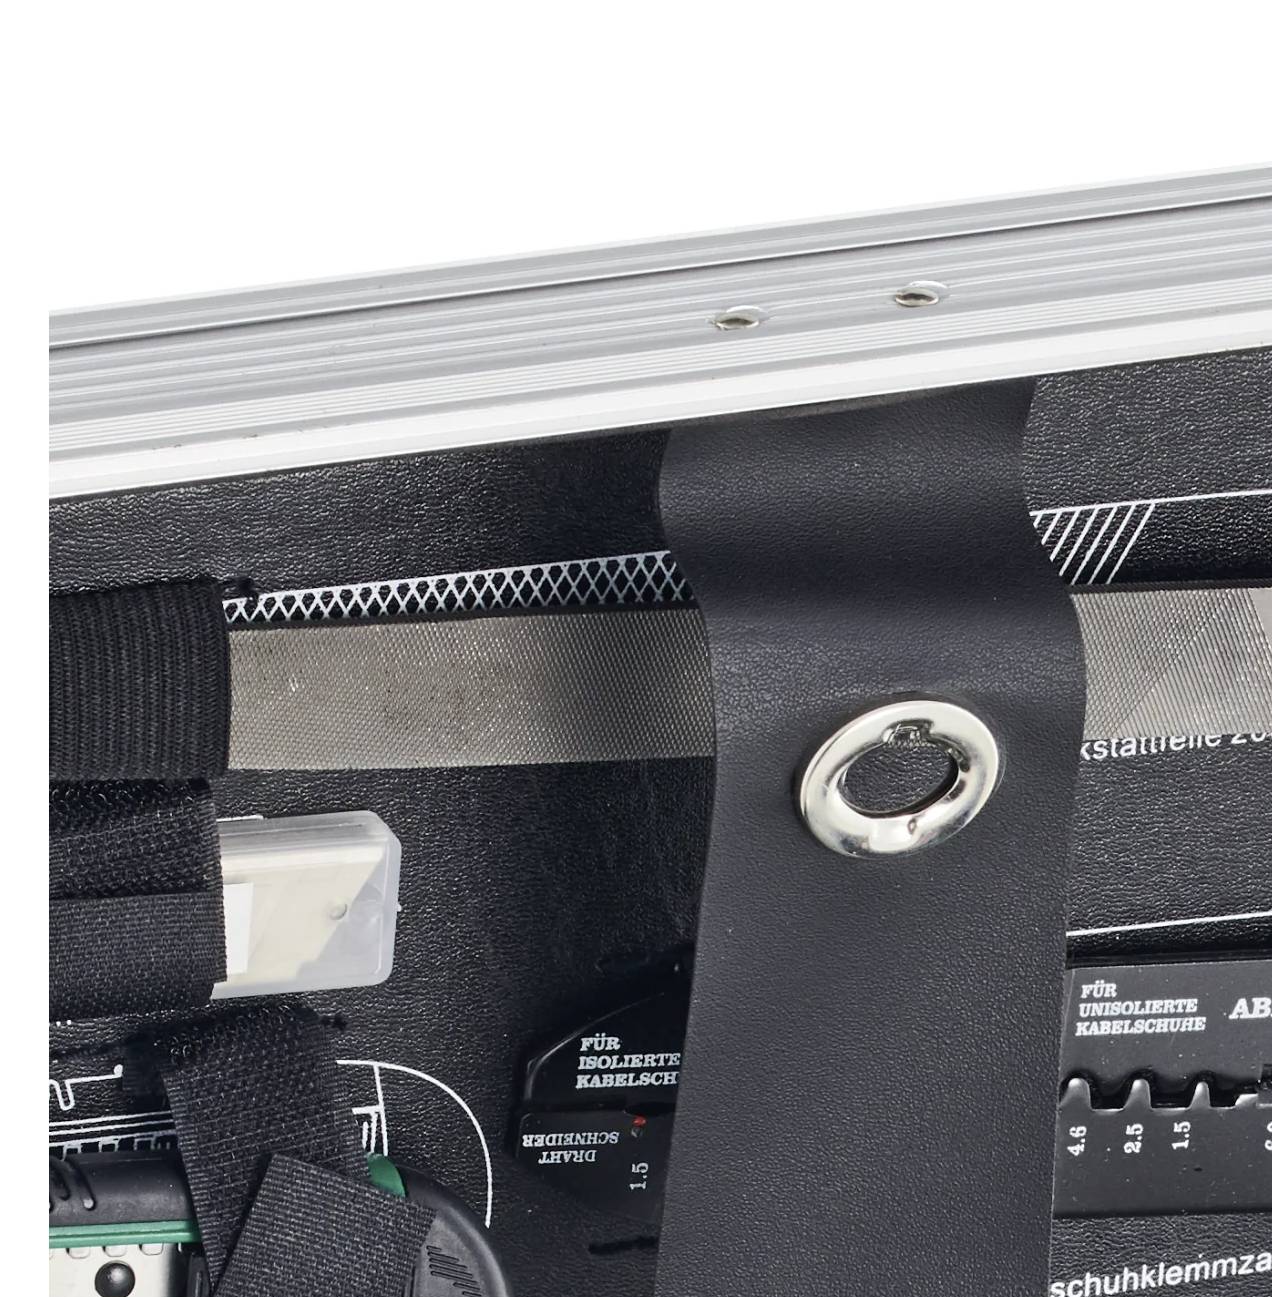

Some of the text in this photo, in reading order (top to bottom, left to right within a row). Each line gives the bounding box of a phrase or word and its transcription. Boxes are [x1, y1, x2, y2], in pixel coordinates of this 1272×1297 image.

[1080, 979, 1117, 999] FÜR
[1079, 998, 1198, 1018] UNISOLIERTE
[1075, 1016, 1206, 1036] KABELSCHUHE
[579, 1032, 622, 1052] FÜR
[577, 1052, 681, 1070] ISOLIERTE
[522, 1131, 619, 1147] SCHNEIDER
[1066, 1125, 1087, 1157] 4.6
[1124, 1123, 1144, 1154] 2.5
[1172, 1120, 1192, 1150] 1.5
[538, 1149, 597, 1164] DRAHT
[629, 1162, 649, 1190] 1.5
